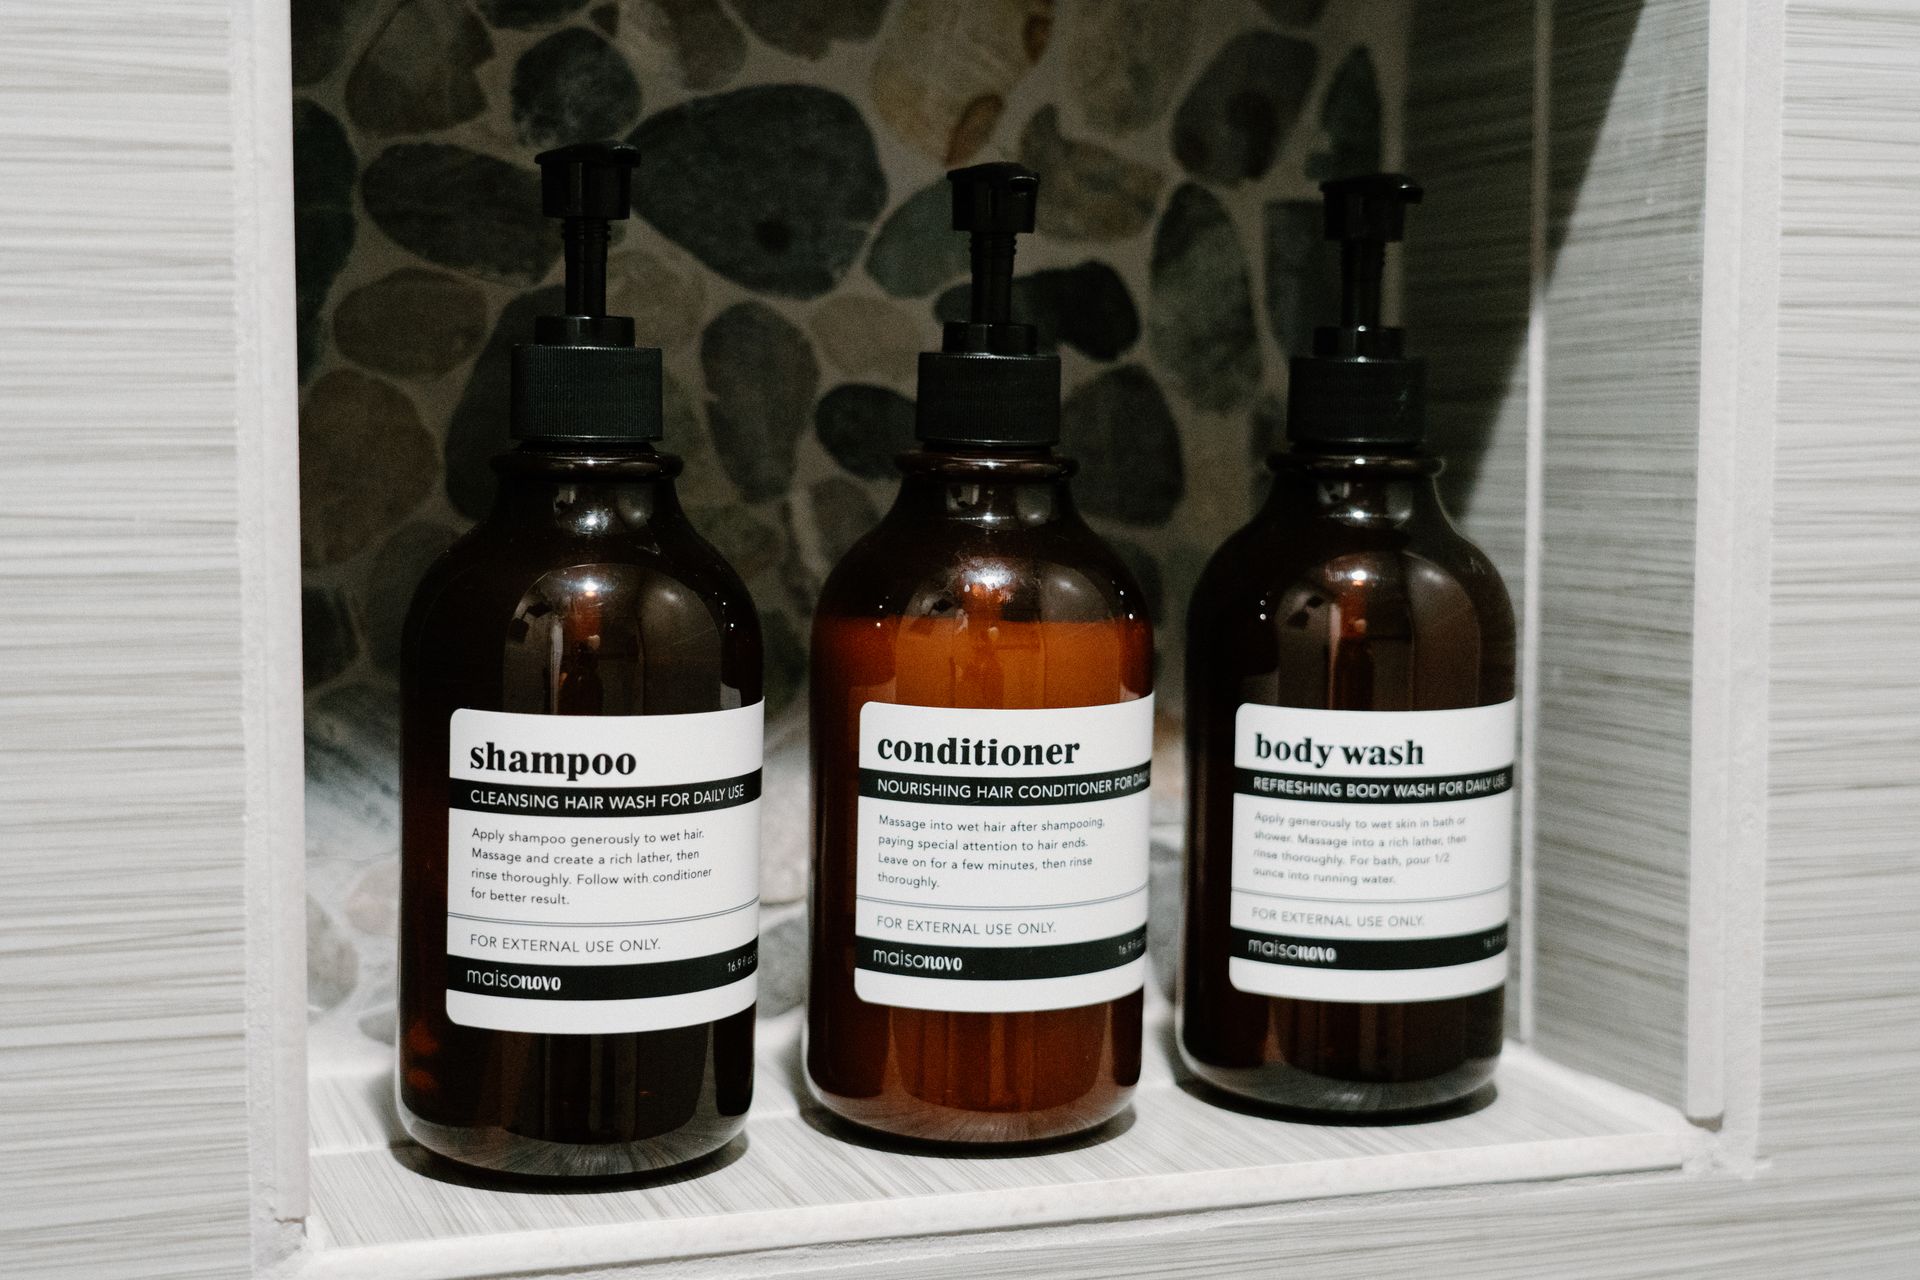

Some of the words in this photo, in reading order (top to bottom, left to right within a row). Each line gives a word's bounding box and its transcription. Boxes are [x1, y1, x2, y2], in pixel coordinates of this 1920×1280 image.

[878, 738, 1080, 765] conditioner
[1255, 732, 1334, 768] body
[1340, 739, 1424, 765] wash
[470, 741, 636, 781] shampoo
[878, 779, 971, 798] NOURISHING
[977, 786, 1013, 798] HAIR
[1018, 780, 1112, 798] CONDITIONER
[1115, 775, 1132, 790] FOR
[1253, 776, 1342, 797] REFRESHING
[1346, 783, 1390, 798] BODY
[1393, 784, 1435, 798] WASH
[1439, 782, 1464, 796] FOR
[1466, 777, 1491, 793] DAILY
[470, 790, 558, 808] CLEANSING
[565, 796, 603, 809] HAIR
[609, 795, 656, 809] WASH
[661, 793, 689, 807] FOR
[694, 788, 726, 804] DAILY
[729, 784, 744, 799] USE
[879, 815, 925, 831] Massage
[930, 819, 953, 830] into
[958, 823, 979, 831] wet
[983, 821, 1006, 831] hair
[1011, 821, 1037, 831] after
[1254, 811, 1285, 826] Apply
[1288, 817, 1351, 830] generously
[1356, 820, 1367, 828] to
[1371, 820, 1392, 828] wet
[1396, 819, 1416, 828] skin
[1420, 819, 1429, 827] in
[1432, 817, 1454, 827] bath
[1457, 817, 1466, 825] or
[472, 828, 504, 843] Apply
[509, 831, 566, 845] shampoo
[571, 833, 640, 847] generously
[644, 834, 656, 843] to
[660, 832, 680, 841] wet
[684, 828, 704, 839] hair.
[878, 836, 913, 849] paying
[918, 840, 958, 851] special
[963, 841, 1017, 851] attention
[1022, 842, 1033, 850] to
[1038, 840, 1058, 850] hair
[1062, 837, 1088, 848] ends.
[1297, 834, 1347, 848] Massage
[1352, 839, 1374, 847] into
[1379, 839, 1384, 847] a
[1389, 836, 1408, 847] rich
[1413, 835, 1443, 846] lather,
[1447, 835, 1466, 844] then
[472, 848, 521, 864] Massage
[526, 853, 549, 863] and
[554, 856, 594, 864] create
[610, 853, 632, 864] rich
[637, 852, 673, 863] lather,
[677, 850, 699, 860] then
[878, 853, 908, 865] Leave
[913, 859, 926, 867] on
[931, 858, 947, 868] for
[962, 859, 983, 870] few
[988, 860, 1038, 871] minutes,
[1042, 859, 1066, 869] then
[1070, 857, 1092, 867] rinse
[1253, 849, 1277, 859] rinse
[1282, 851, 1344, 866] thoroughly.
[1350, 855, 1369, 865] For
[1373, 855, 1401, 866] bath,
[1406, 857, 1430, 867] pour
[472, 868, 497, 880] rinse
[502, 871, 572, 887] thoroughly.
[577, 874, 619, 884] Follow
[623, 873, 648, 883] with
[653, 868, 712, 882] conditioner
[878, 872, 940, 890] thoroughly.
[1253, 867, 1284, 878] ounce
[1288, 870, 1309, 880] into
[1313, 874, 1357, 885] running
[471, 887, 486, 899] for
[490, 889, 526, 902] better
[531, 894, 569, 904] result.
[877, 916, 901, 929] FOR
[907, 919, 979, 935] EXTERNAL
[985, 923, 1011, 935] USE
[1018, 921, 1056, 934] ONLY.
[1252, 907, 1277, 920] FOR
[1281, 912, 1351, 926] EXTERNAL
[1357, 916, 1382, 927] USE
[470, 934, 497, 948] FOR
[502, 937, 580, 953] EXTERNAL
[585, 941, 614, 953] USE
[619, 938, 660, 951] ONLY.
[1248, 939, 1337, 963] maisonovo
[873, 950, 962, 971] maisonovo
[467, 969, 561, 991] maisonovo
